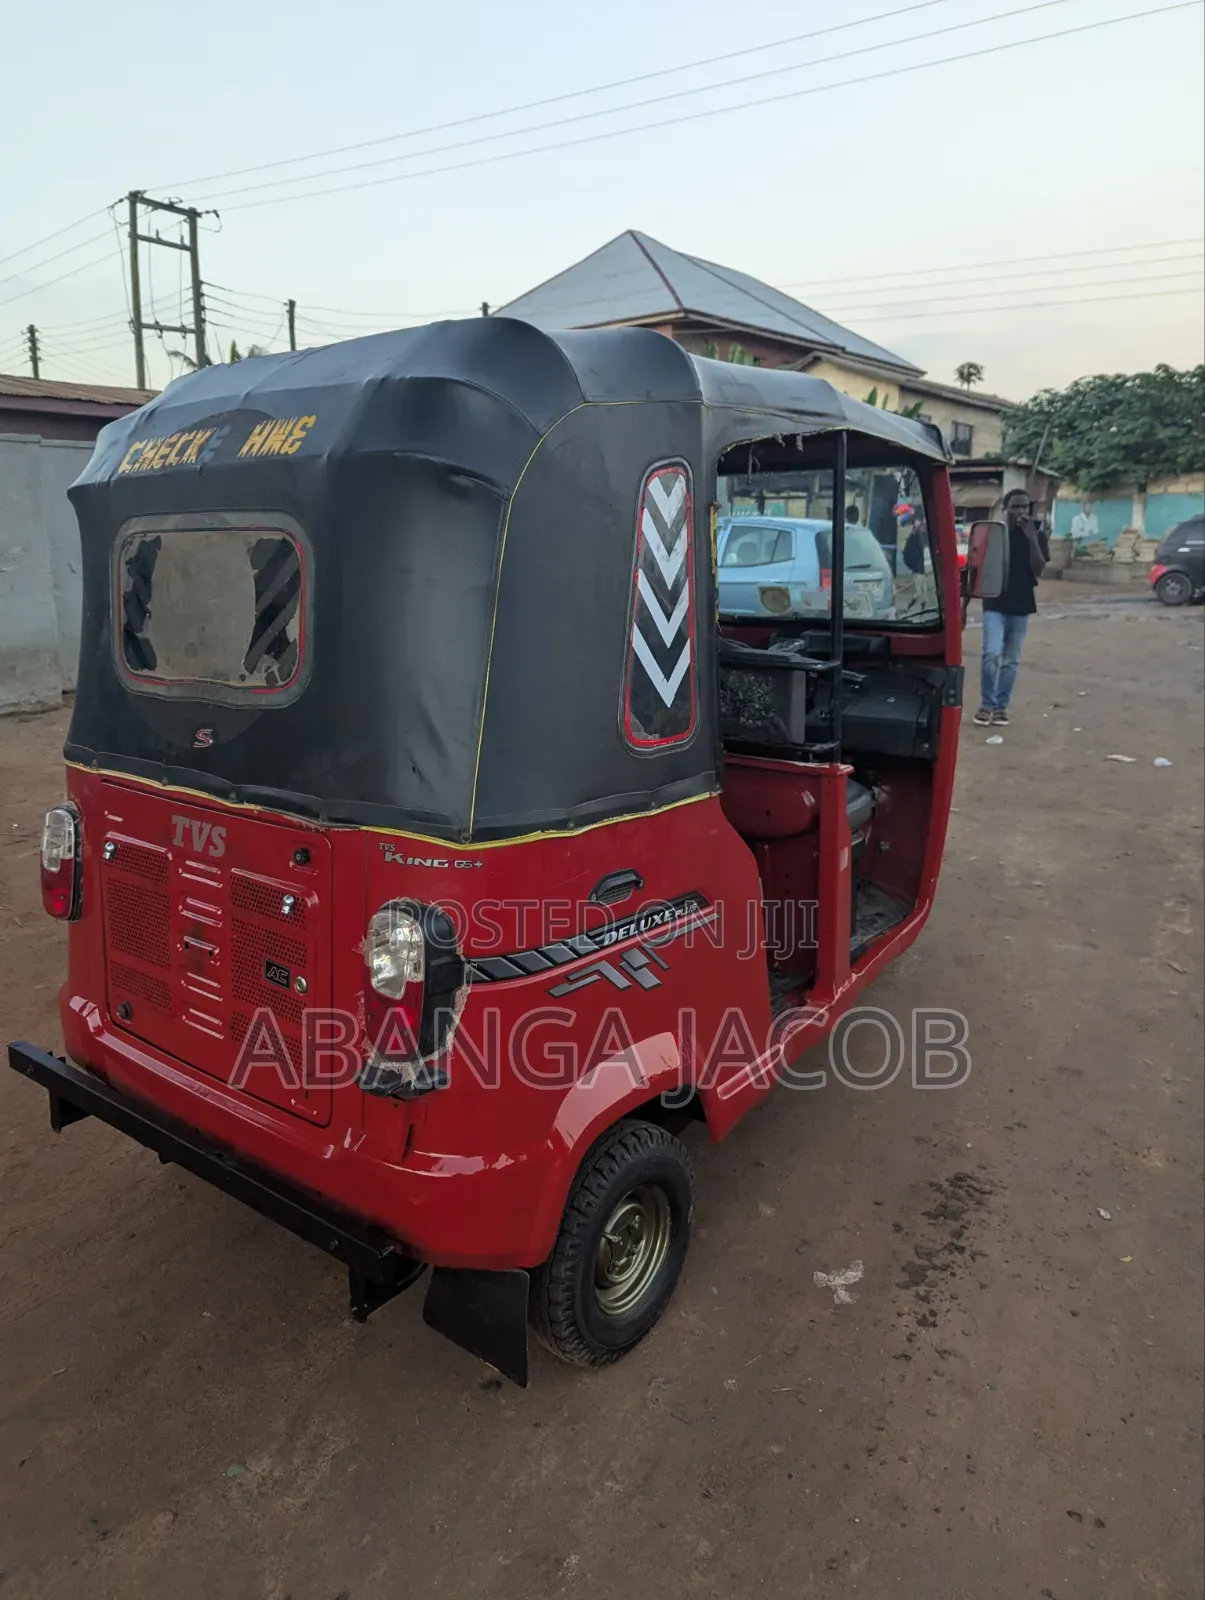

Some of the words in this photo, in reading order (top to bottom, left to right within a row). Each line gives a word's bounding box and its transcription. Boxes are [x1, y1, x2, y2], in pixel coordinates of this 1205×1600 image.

[171, 814, 228, 858] TVS
[378, 842, 396, 852] TVS
[603, 907, 676, 947] DELUXE
[266, 965, 289, 985] AC
